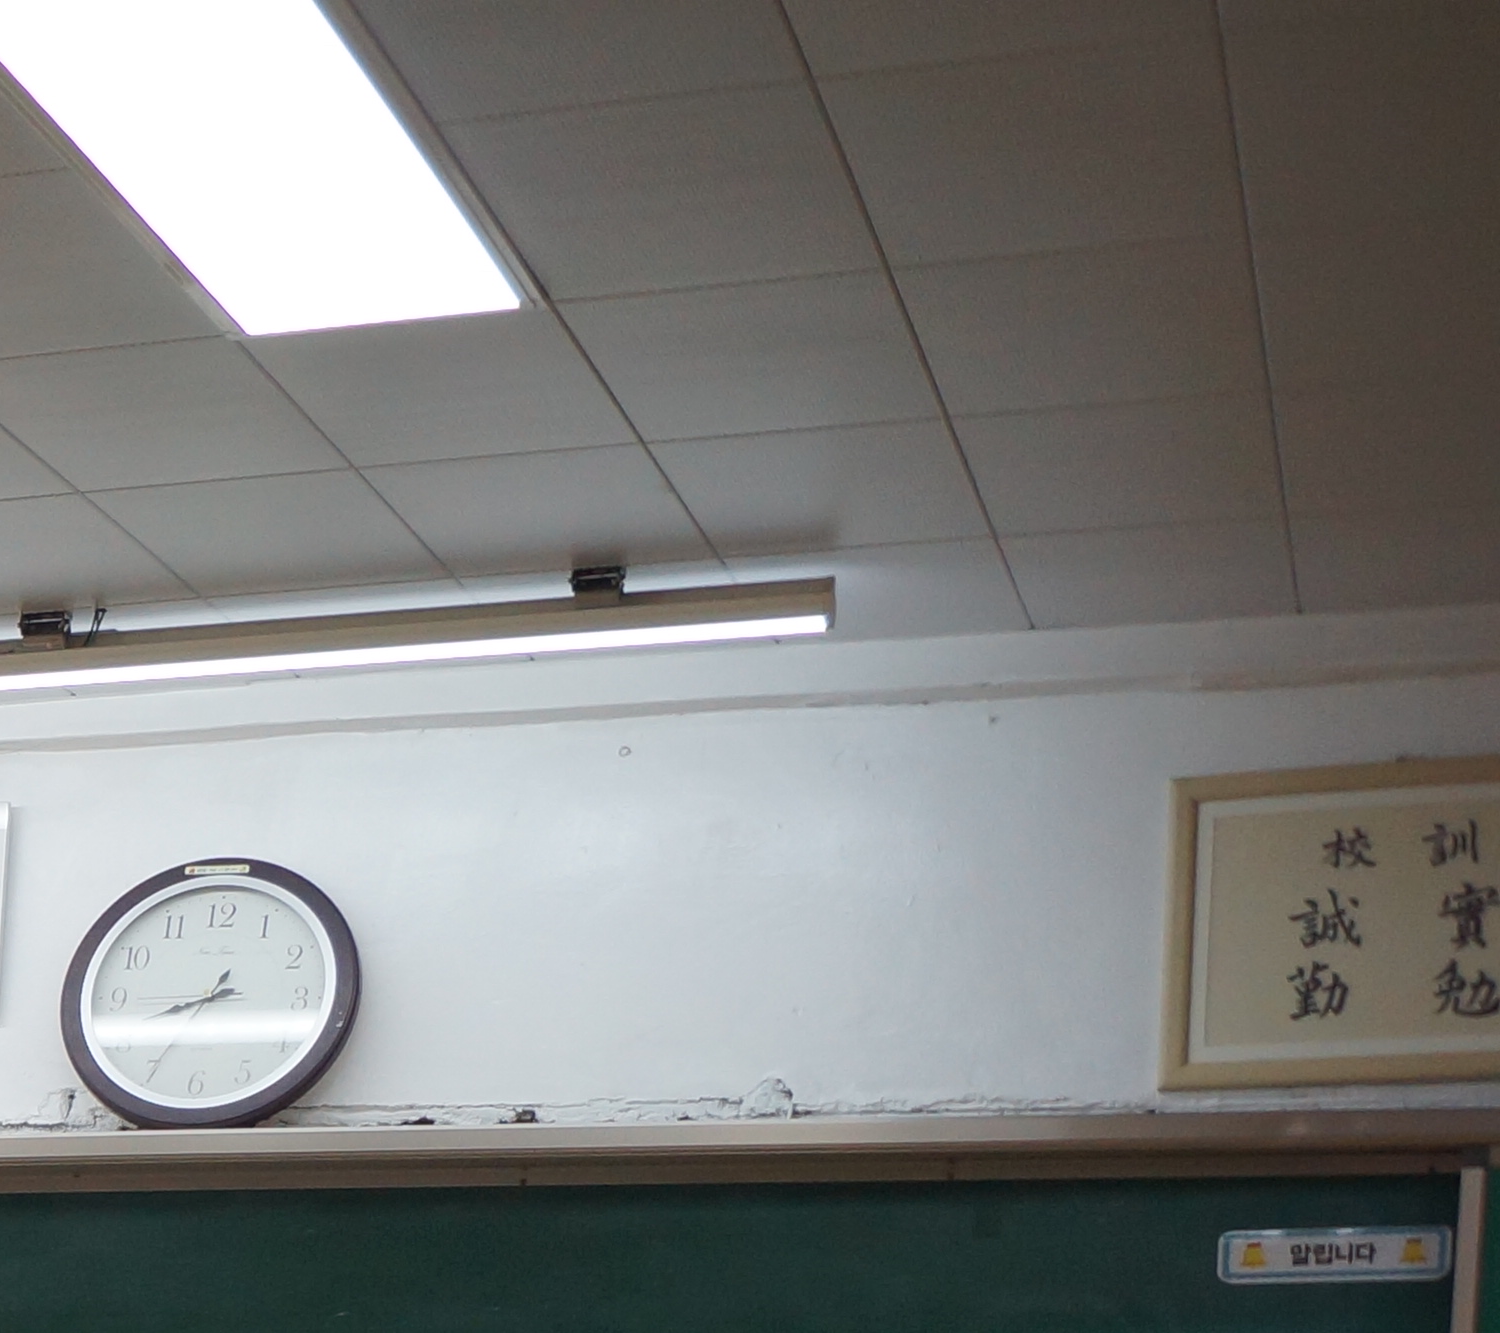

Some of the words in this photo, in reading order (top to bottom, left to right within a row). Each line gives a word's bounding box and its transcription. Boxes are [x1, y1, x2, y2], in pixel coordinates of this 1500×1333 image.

[1323, 819, 1478, 868] 校訓
[163, 914, 185, 940] 11
[206, 902, 238, 928] 12
[259, 914, 270, 940] 1
[123, 945, 150, 971] 10
[285, 944, 303, 970] 2
[109, 987, 127, 1012] 9
[291, 986, 309, 1012] 3
[1287, 958, 1500, 1020] 勤勉
[146, 1059, 161, 1084] 7
[187, 1070, 205, 1096] 6
[234, 1059, 252, 1085] 5
[1290, 1241, 1377, 1266] 알립니다
